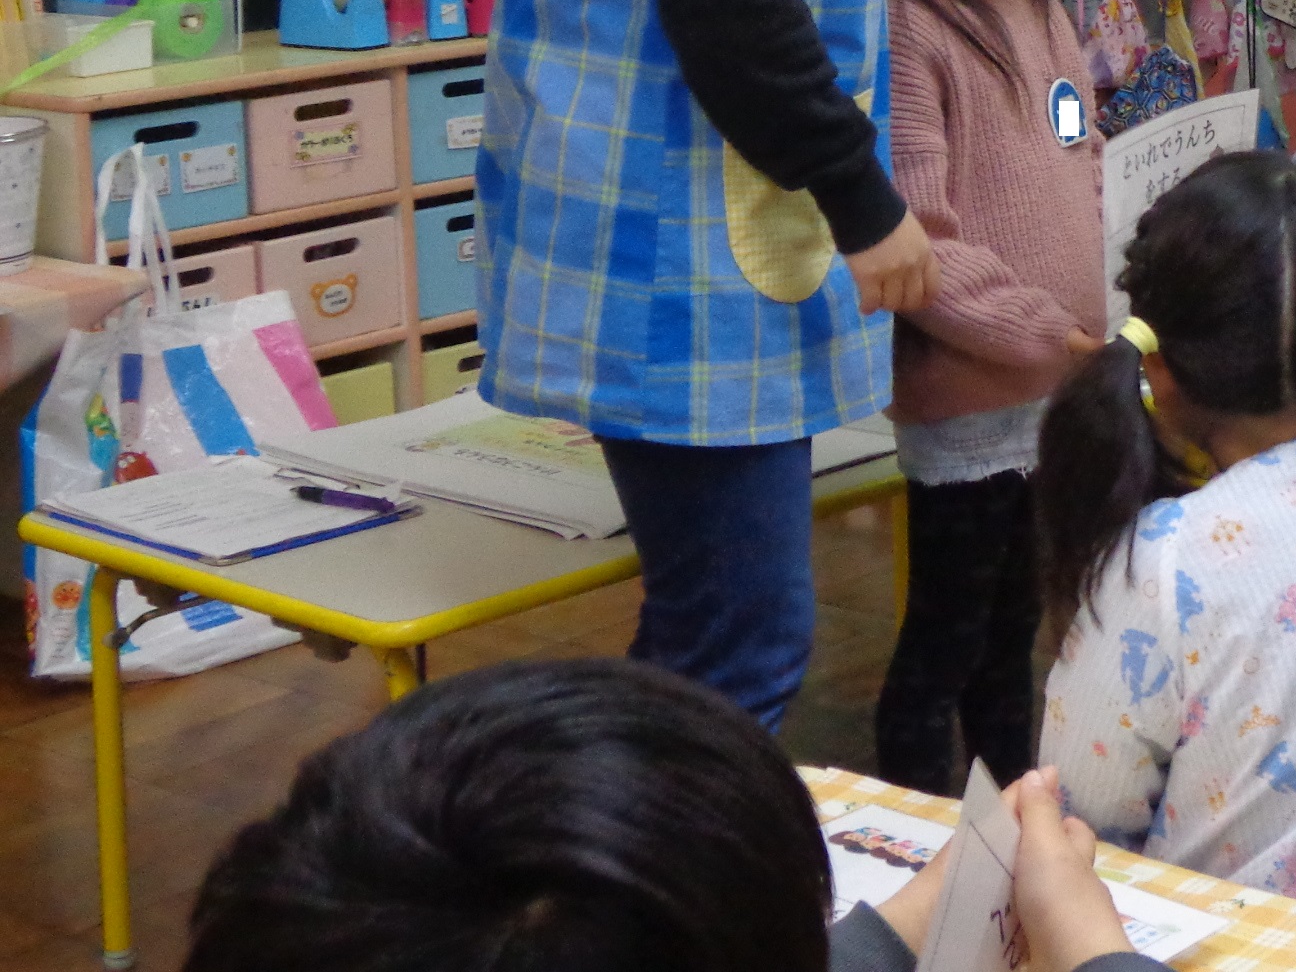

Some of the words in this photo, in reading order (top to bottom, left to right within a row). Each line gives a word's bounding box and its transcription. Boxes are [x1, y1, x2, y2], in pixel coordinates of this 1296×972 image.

[1122, 119, 1216, 180] といれでうんち
